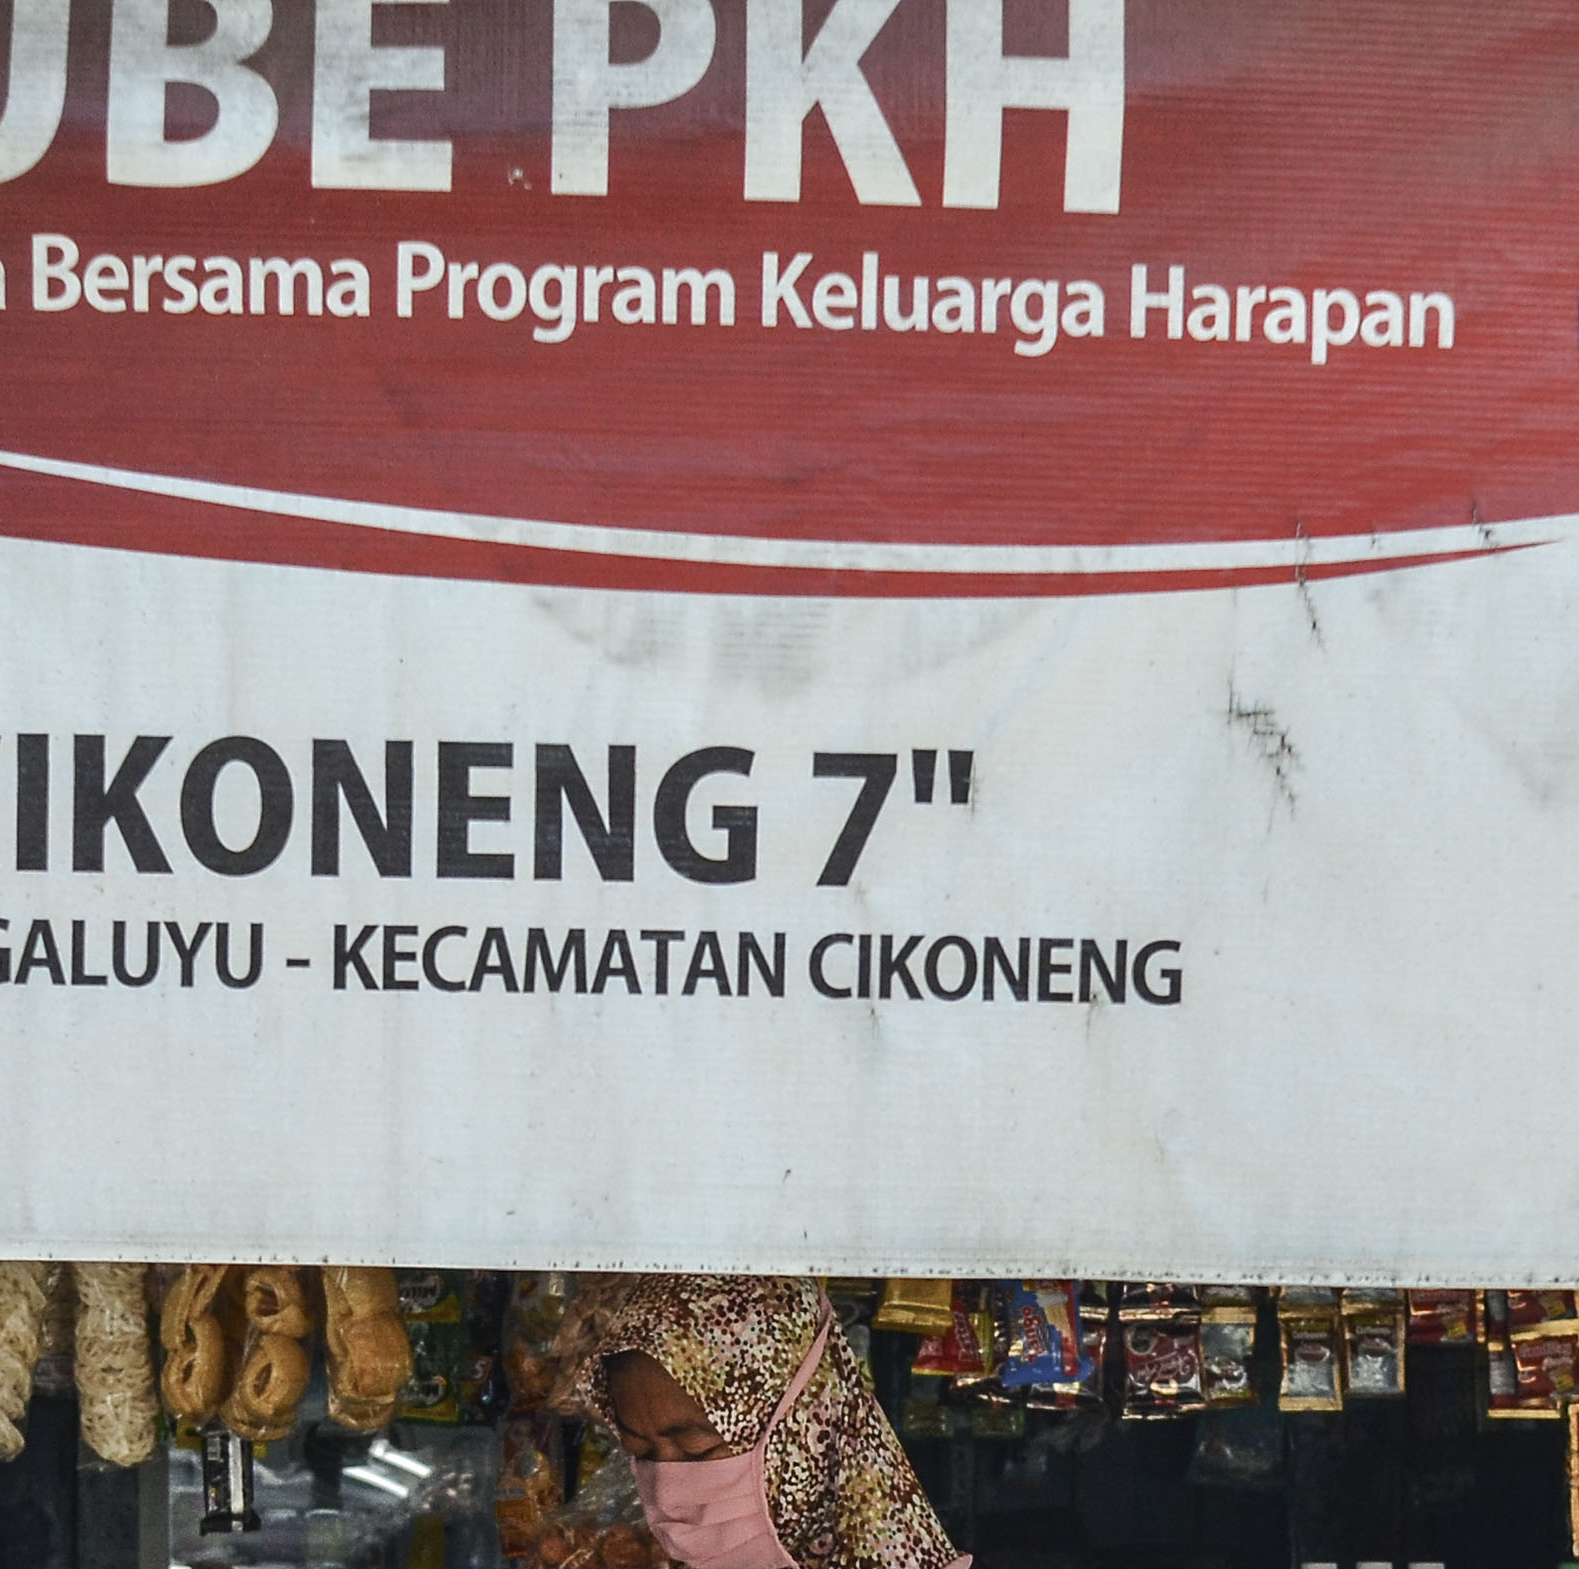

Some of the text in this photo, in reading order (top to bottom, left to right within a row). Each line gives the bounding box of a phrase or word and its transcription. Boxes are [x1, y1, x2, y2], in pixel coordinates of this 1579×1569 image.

[551, 0, 1126, 214] PKH
[31, 234, 369, 318] Bersama
[396, 241, 736, 343] Program
[761, 252, 1104, 357] Keluarga
[1130, 264, 1455, 364] Harapan
[333, 922, 787, 998] KECAMATAN
[808, 931, 1184, 1006] CIKONENG
